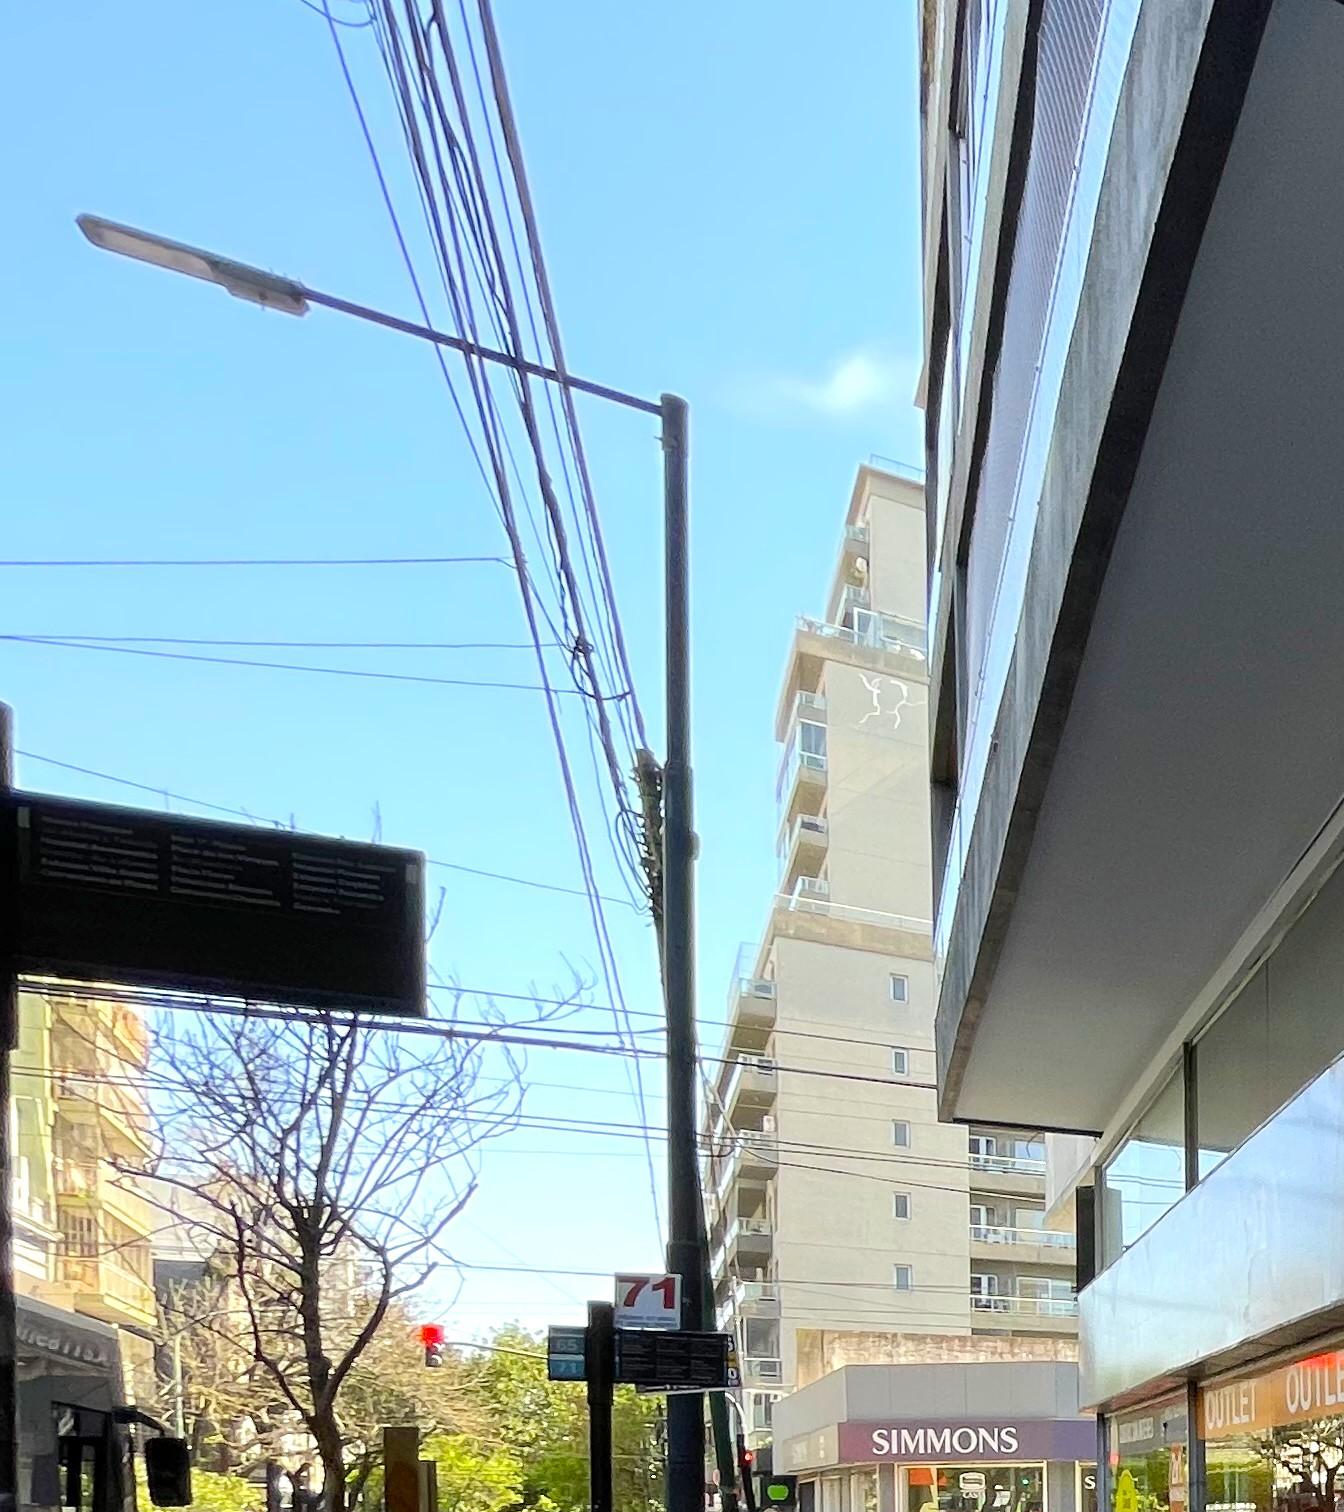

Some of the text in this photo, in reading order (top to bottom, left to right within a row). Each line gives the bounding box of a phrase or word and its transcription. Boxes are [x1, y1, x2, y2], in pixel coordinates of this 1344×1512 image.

[618, 1276, 677, 1310] 71
[1206, 1379, 1258, 1430] OUTLET
[871, 1426, 1019, 1456] SIMMONS
